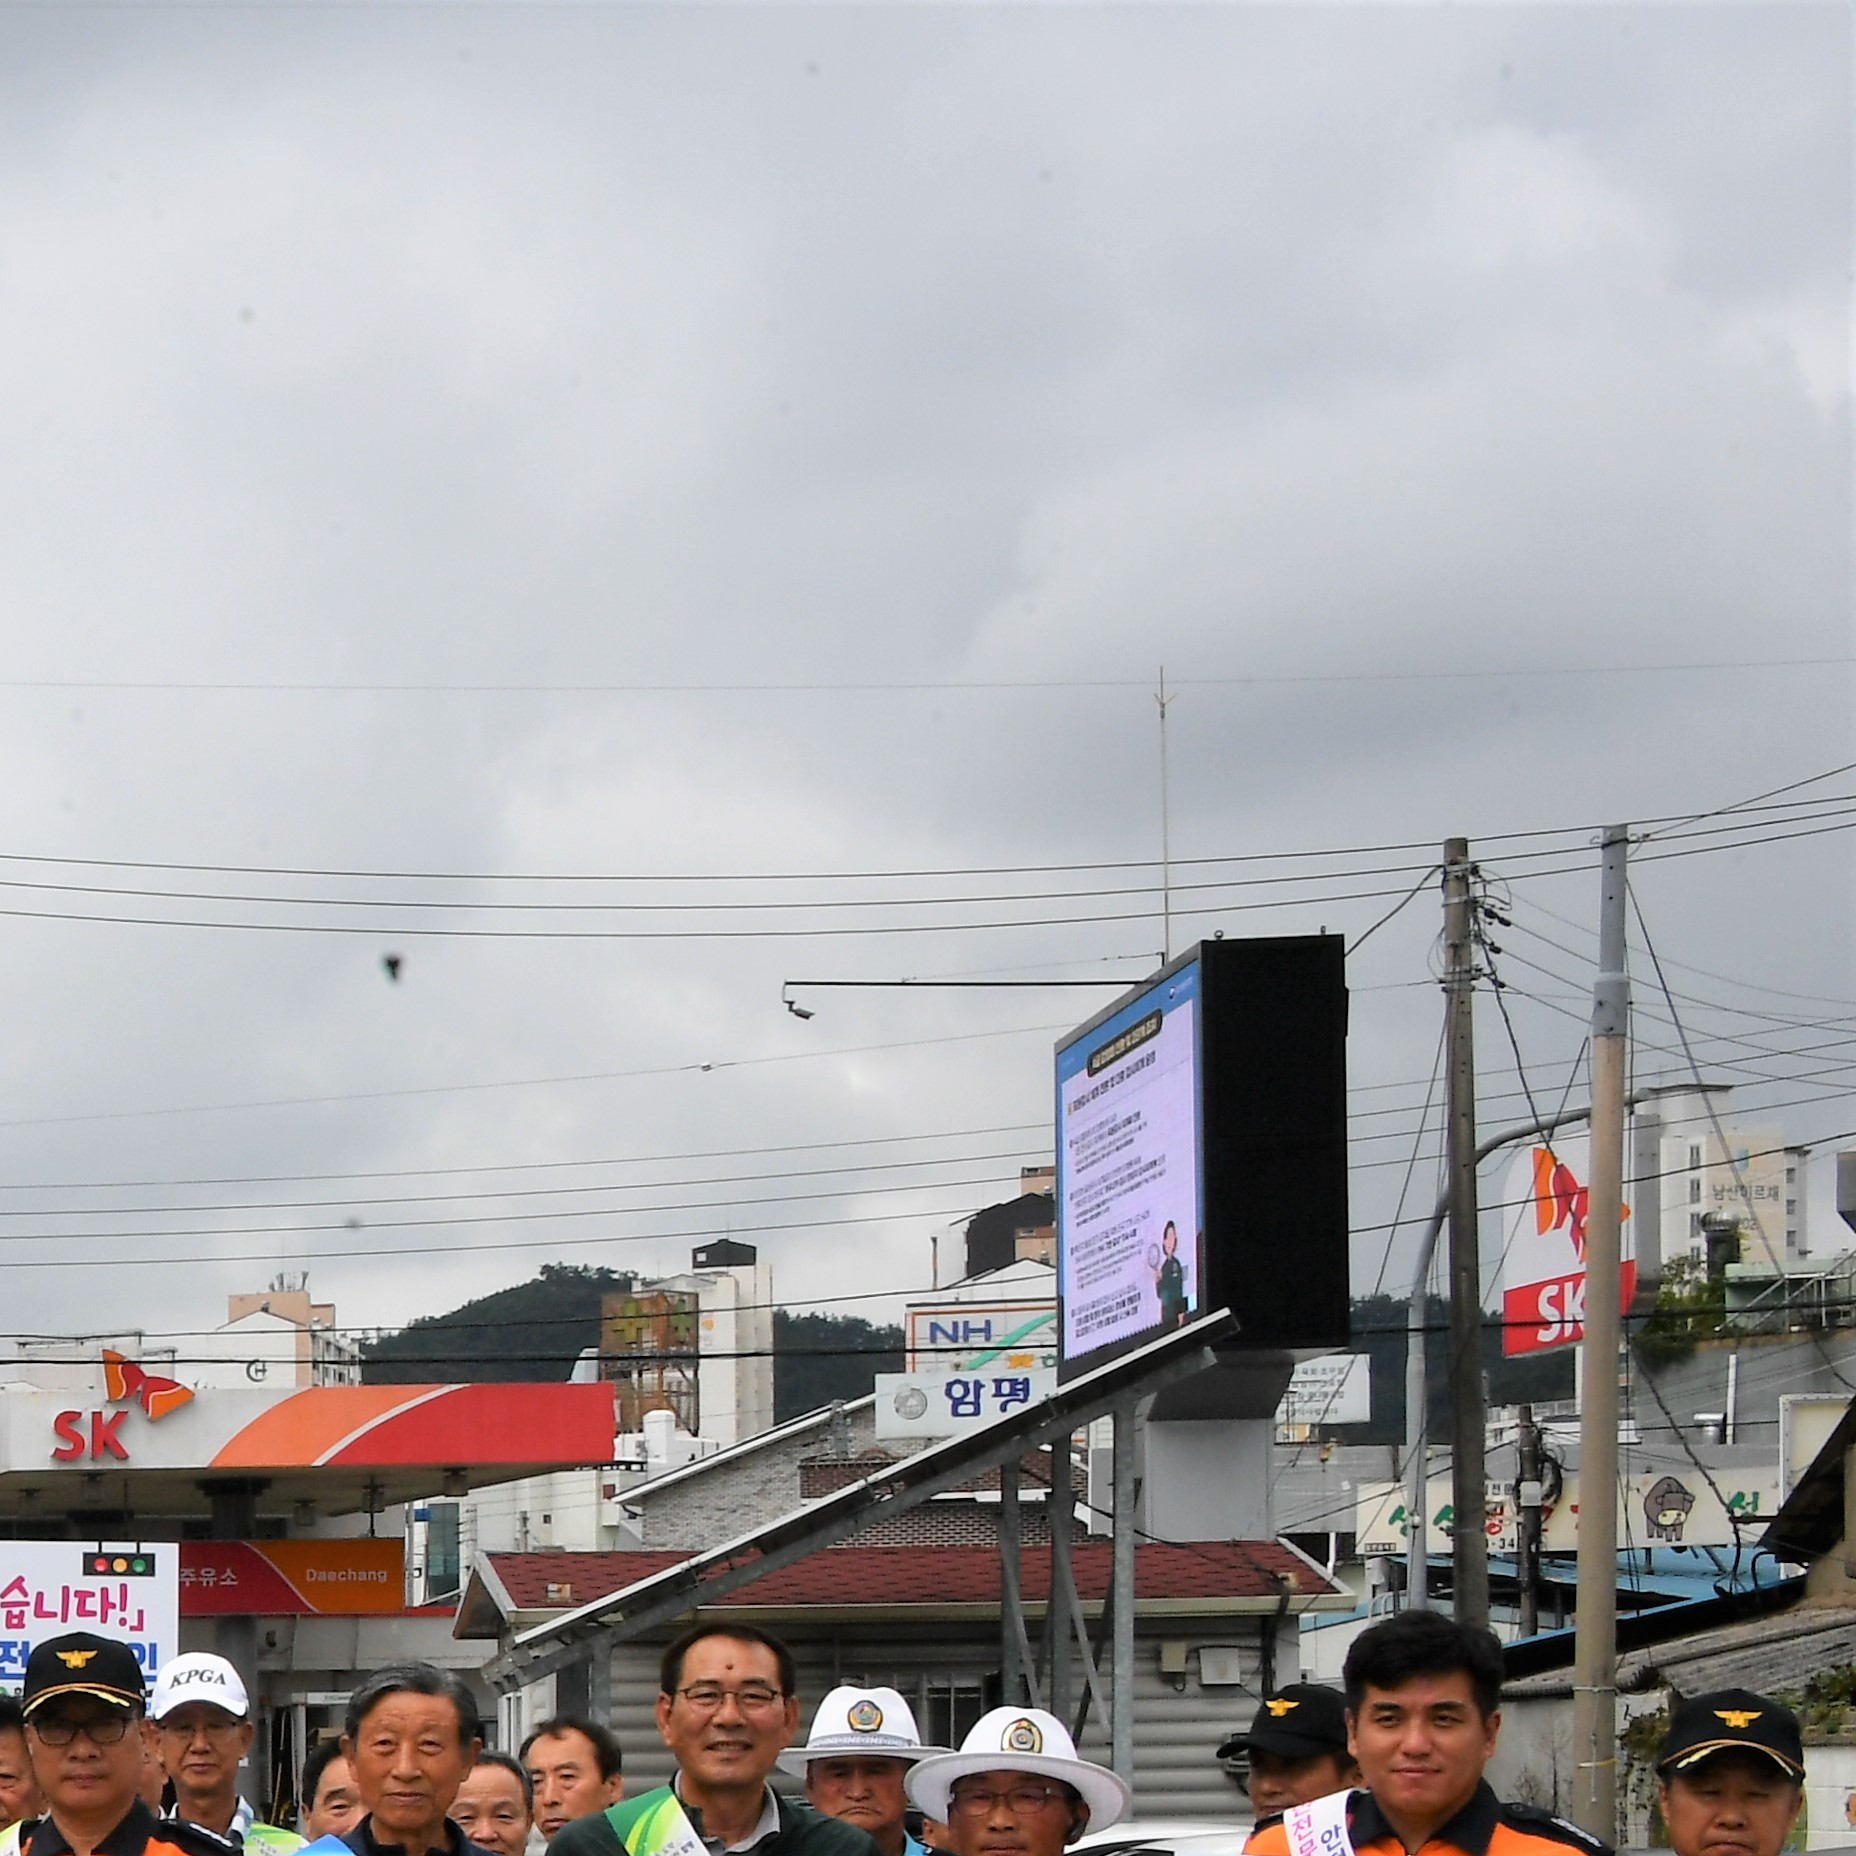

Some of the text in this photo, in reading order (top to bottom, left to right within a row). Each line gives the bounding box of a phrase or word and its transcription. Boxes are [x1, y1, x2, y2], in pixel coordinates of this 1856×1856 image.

[929, 1319, 992, 1344] NH
[944, 1376, 1031, 1418] 함평
[51, 1409, 129, 1461] SK
[180, 1565, 388, 1587] 주유소 Daechang
[168, 1667, 227, 1690] KPGA
